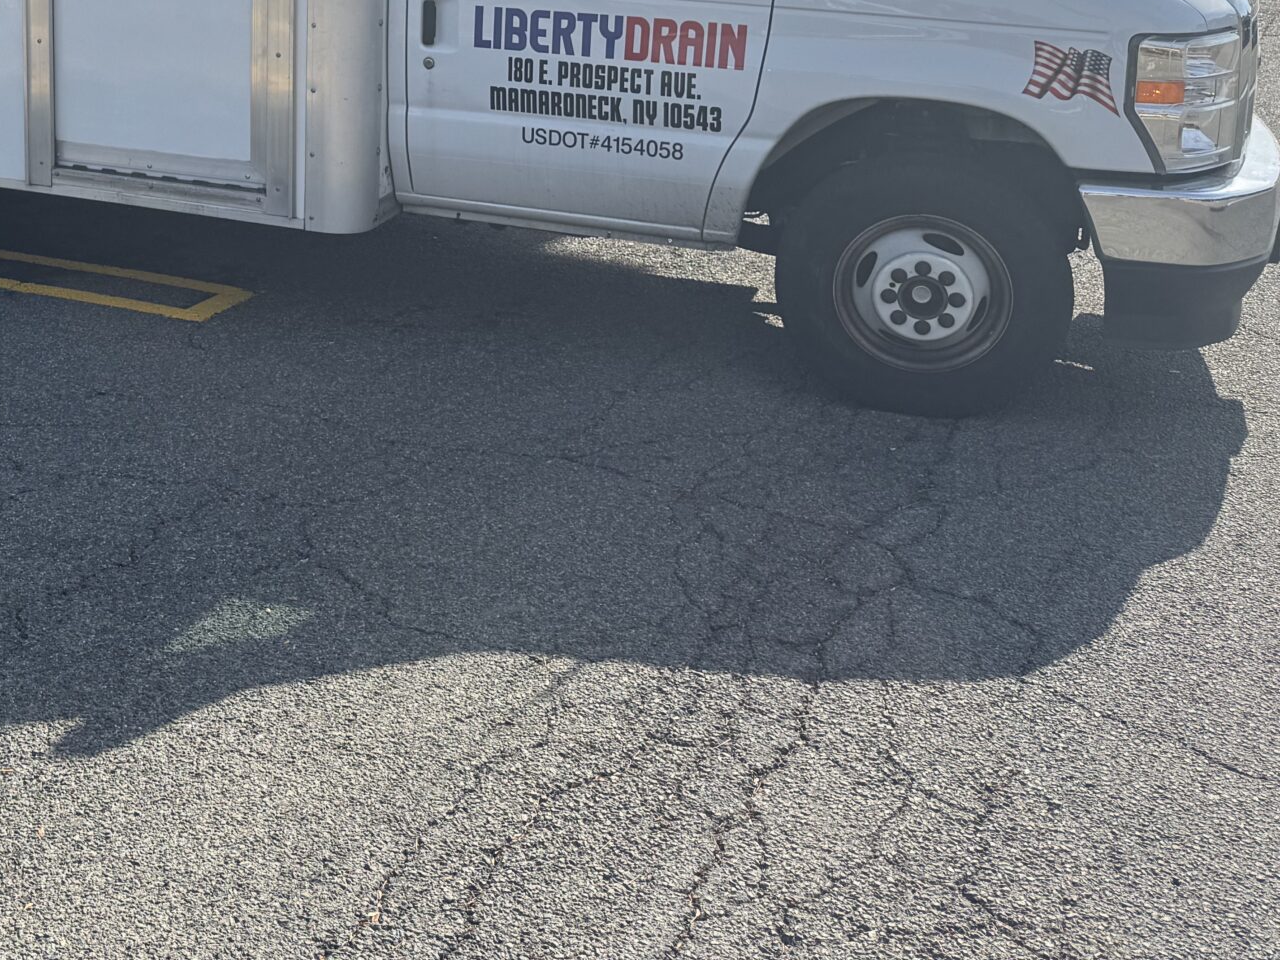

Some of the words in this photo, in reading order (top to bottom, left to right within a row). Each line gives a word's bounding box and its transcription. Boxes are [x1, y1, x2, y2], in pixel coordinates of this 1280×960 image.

[473, 5, 748, 71] LIBERTYDRAIN
[507, 56, 534, 84] 180
[539, 59, 553, 87] E.
[557, 61, 654, 96] PROSPECT
[659, 70, 701, 100] AVE.
[489, 86, 627, 125] MAMARONECK,
[632, 98, 658, 127] NY
[663, 102, 722, 133] 10543
[521, 126, 684, 161] USDOT#4154058
